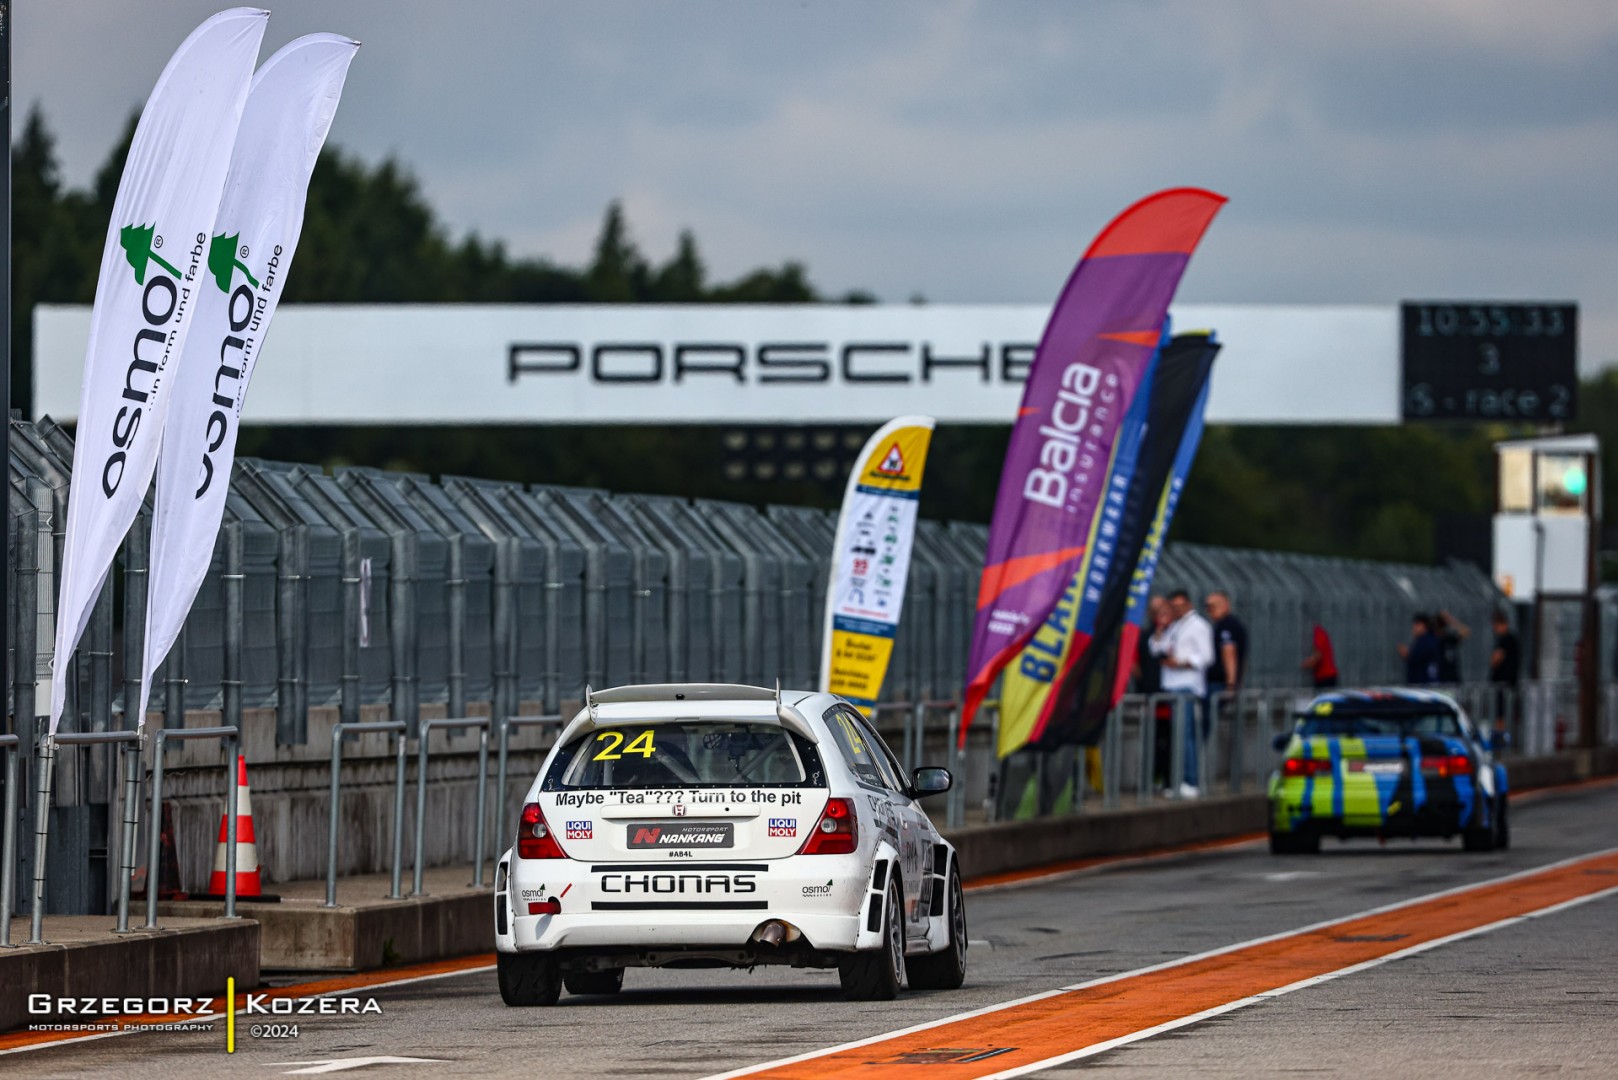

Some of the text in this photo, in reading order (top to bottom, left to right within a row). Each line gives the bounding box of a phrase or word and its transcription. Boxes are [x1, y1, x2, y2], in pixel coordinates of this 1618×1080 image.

[250, 297, 267, 332] und
[262, 244, 283, 292] farbe
[158, 330, 177, 372] form
[175, 287, 191, 323] und
[185, 232, 206, 282] farbe
[508, 342, 1037, 386] PORSCHE
[103, 275, 178, 500] osmo
[1023, 362, 1101, 508] Balcia
[1066, 373, 1118, 514] insurance
[1086, 474, 1128, 603] WORKWEAR
[592, 730, 657, 761] 24
[556, 792, 604, 808] Maybe
[689, 790, 725, 803] Turn
[730, 790, 746, 803] to
[751, 790, 776, 803] the
[781, 791, 801, 806] pit
[567, 822, 592, 830] LIQUI
[769, 819, 796, 828] LIQUI
[769, 828, 796, 836] MOLY
[567, 830, 592, 839] MOLY
[658, 834, 725, 844] NANKANG
[601, 874, 756, 893] CHONAS
[802, 886, 829, 894] osmo
[522, 889, 542, 898] osmo
